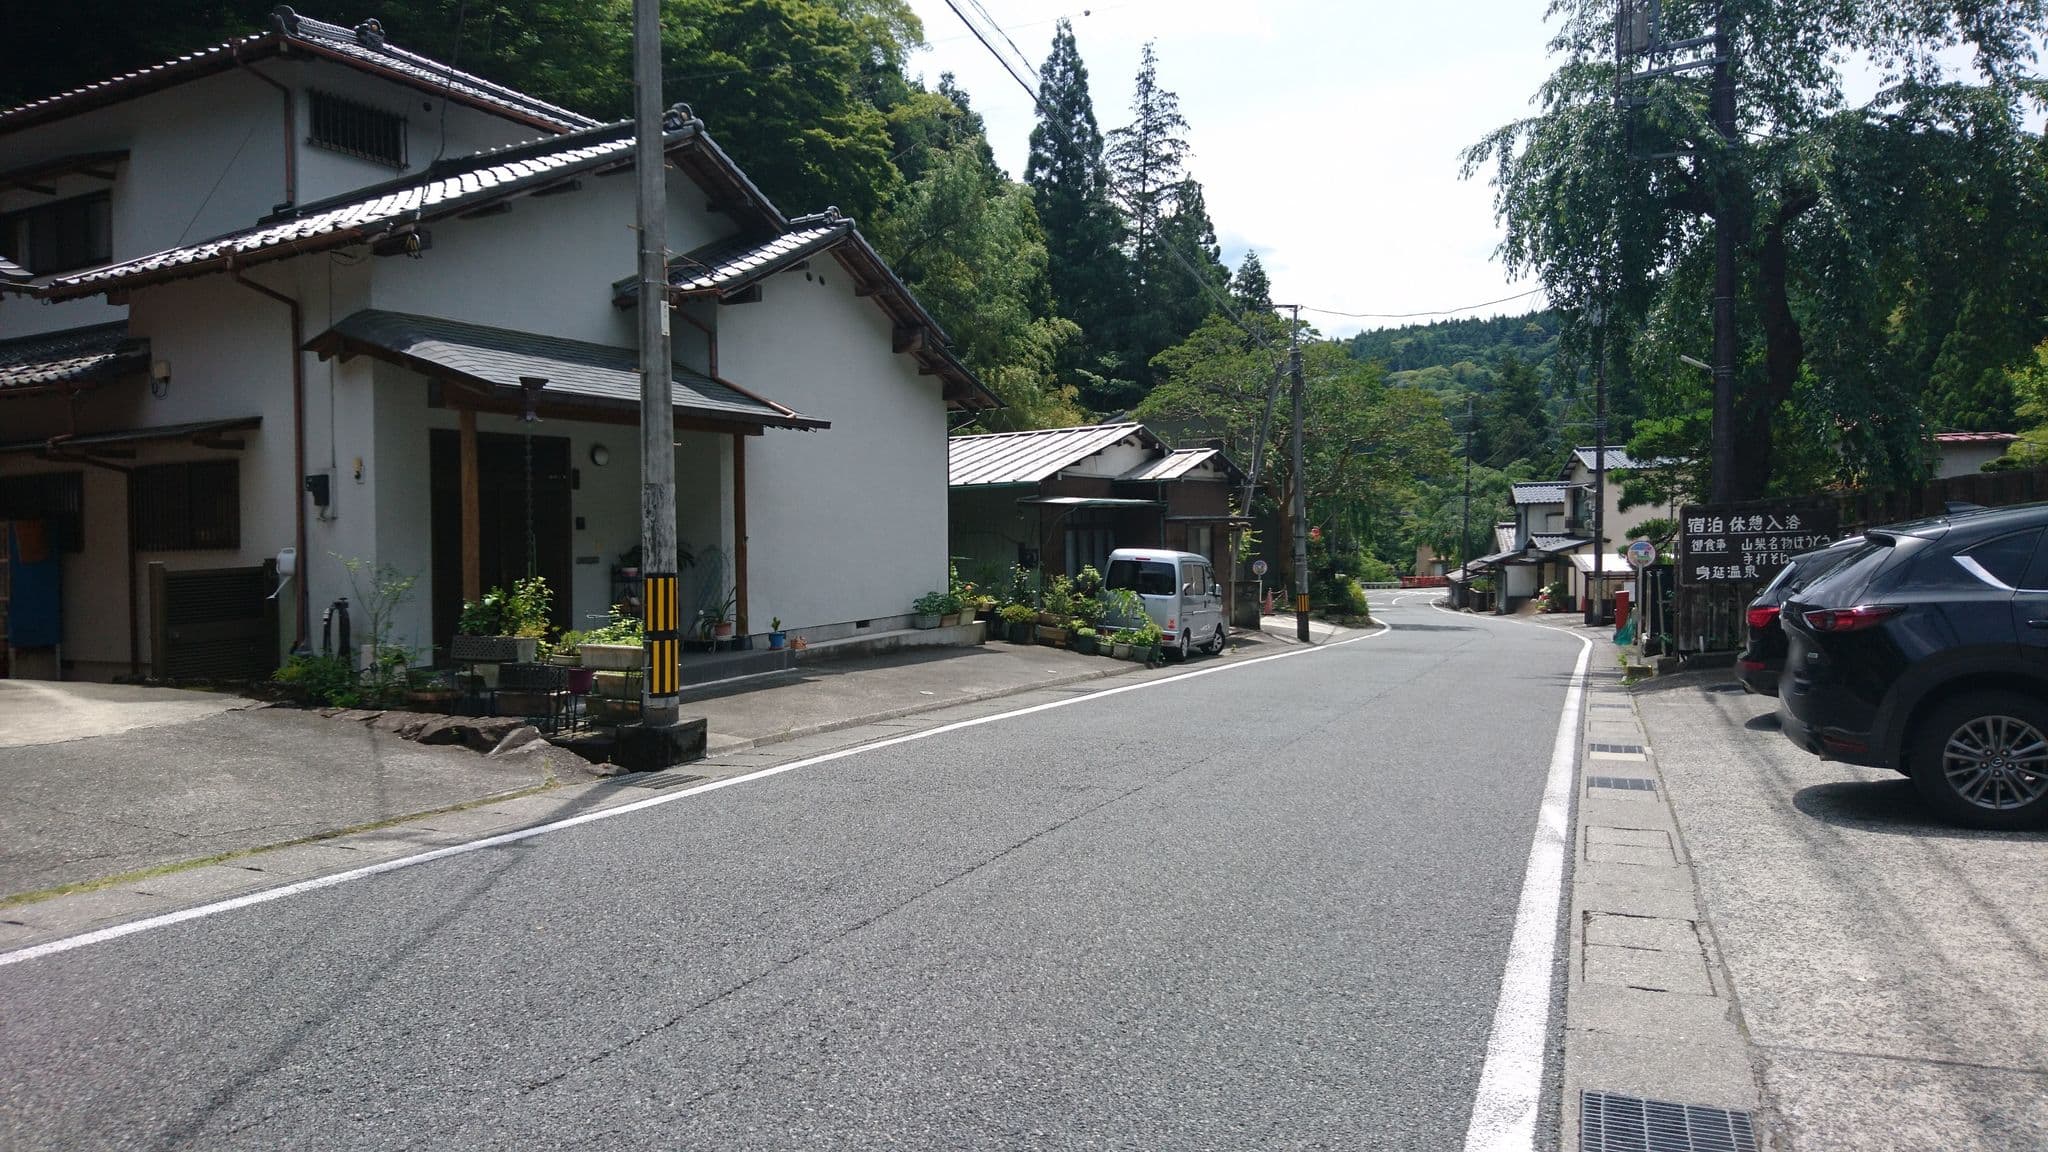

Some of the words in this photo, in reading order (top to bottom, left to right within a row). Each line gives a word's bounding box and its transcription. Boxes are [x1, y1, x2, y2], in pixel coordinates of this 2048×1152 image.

[1688, 517, 1723, 533] 宿泊
[1767, 514, 1801, 530] 入浴
[1696, 565, 1759, 580] 身延温泉
